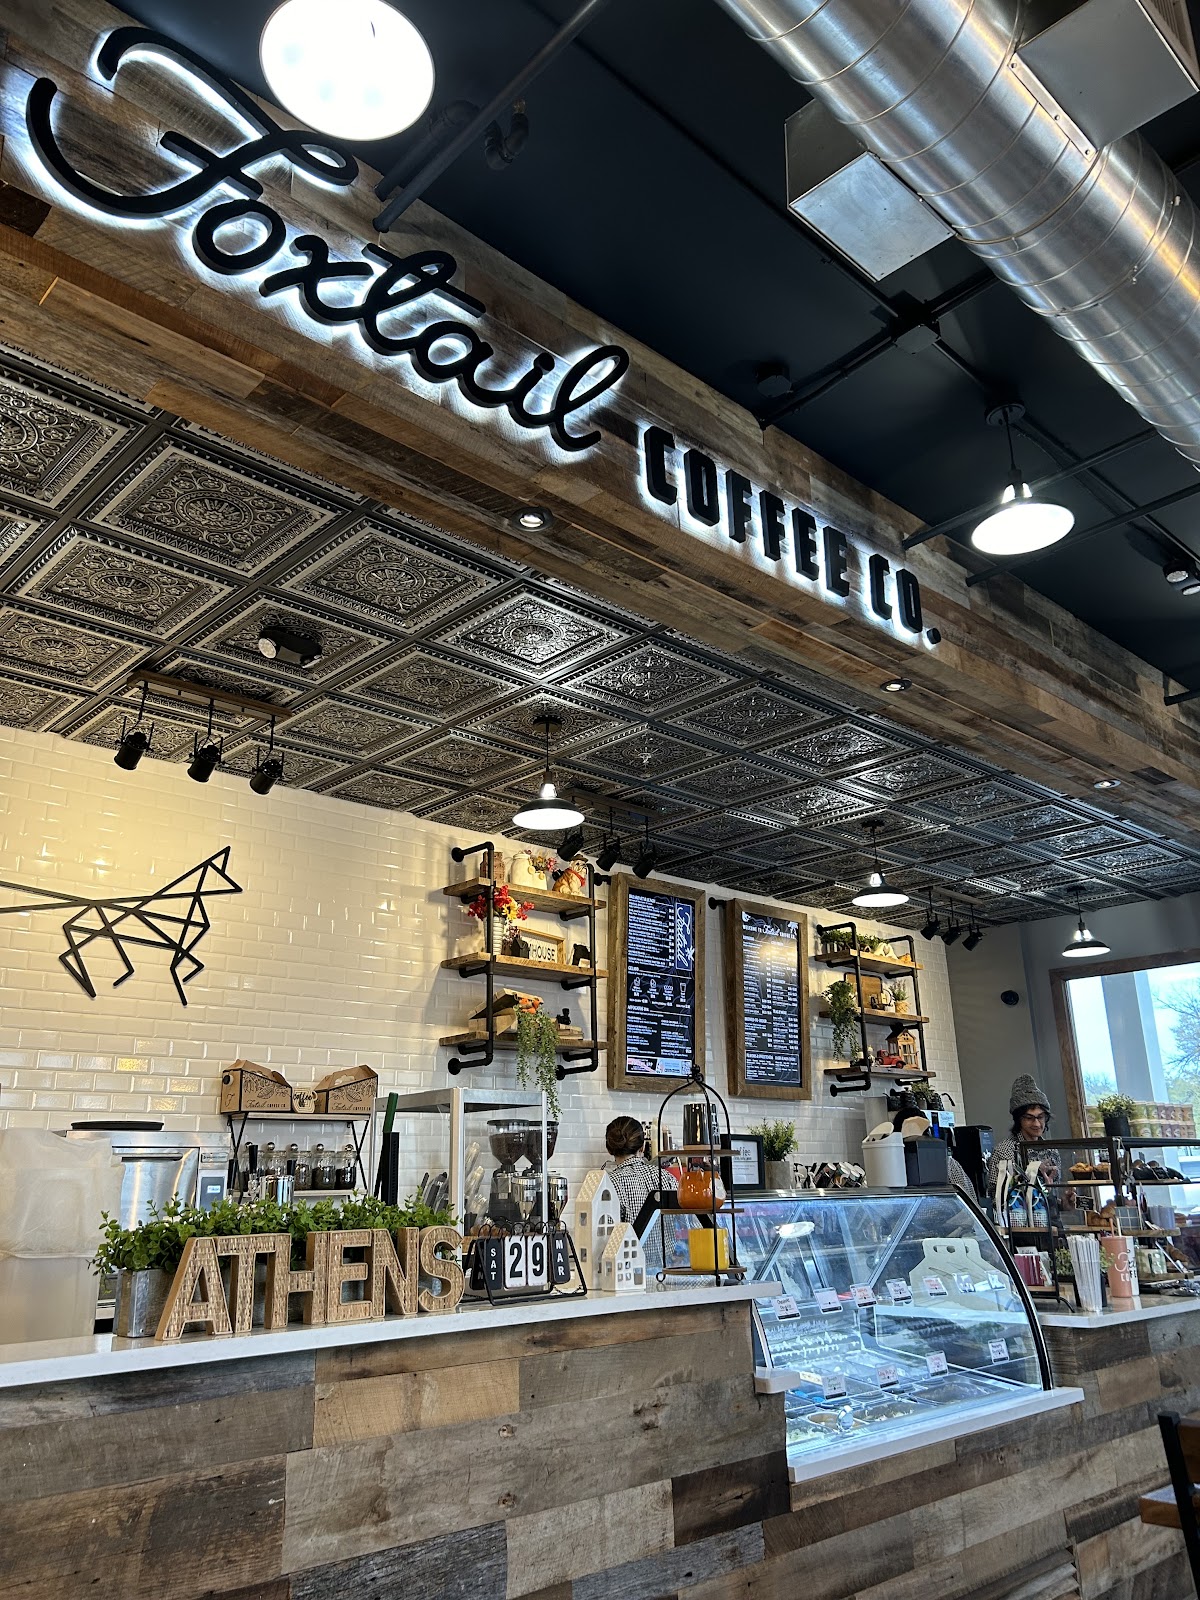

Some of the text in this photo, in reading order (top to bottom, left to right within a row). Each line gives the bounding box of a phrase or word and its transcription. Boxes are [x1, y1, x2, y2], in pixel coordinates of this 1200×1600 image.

[26, 26, 942, 645] Foxtail COFFEE CO.
[530, 944, 556, 962] HOUSE
[293, 1092, 312, 1101] coffee
[509, 1241, 545, 1279] 29
[555, 1239, 566, 1276] MAR
[155, 1225, 465, 1341] ATHENS
